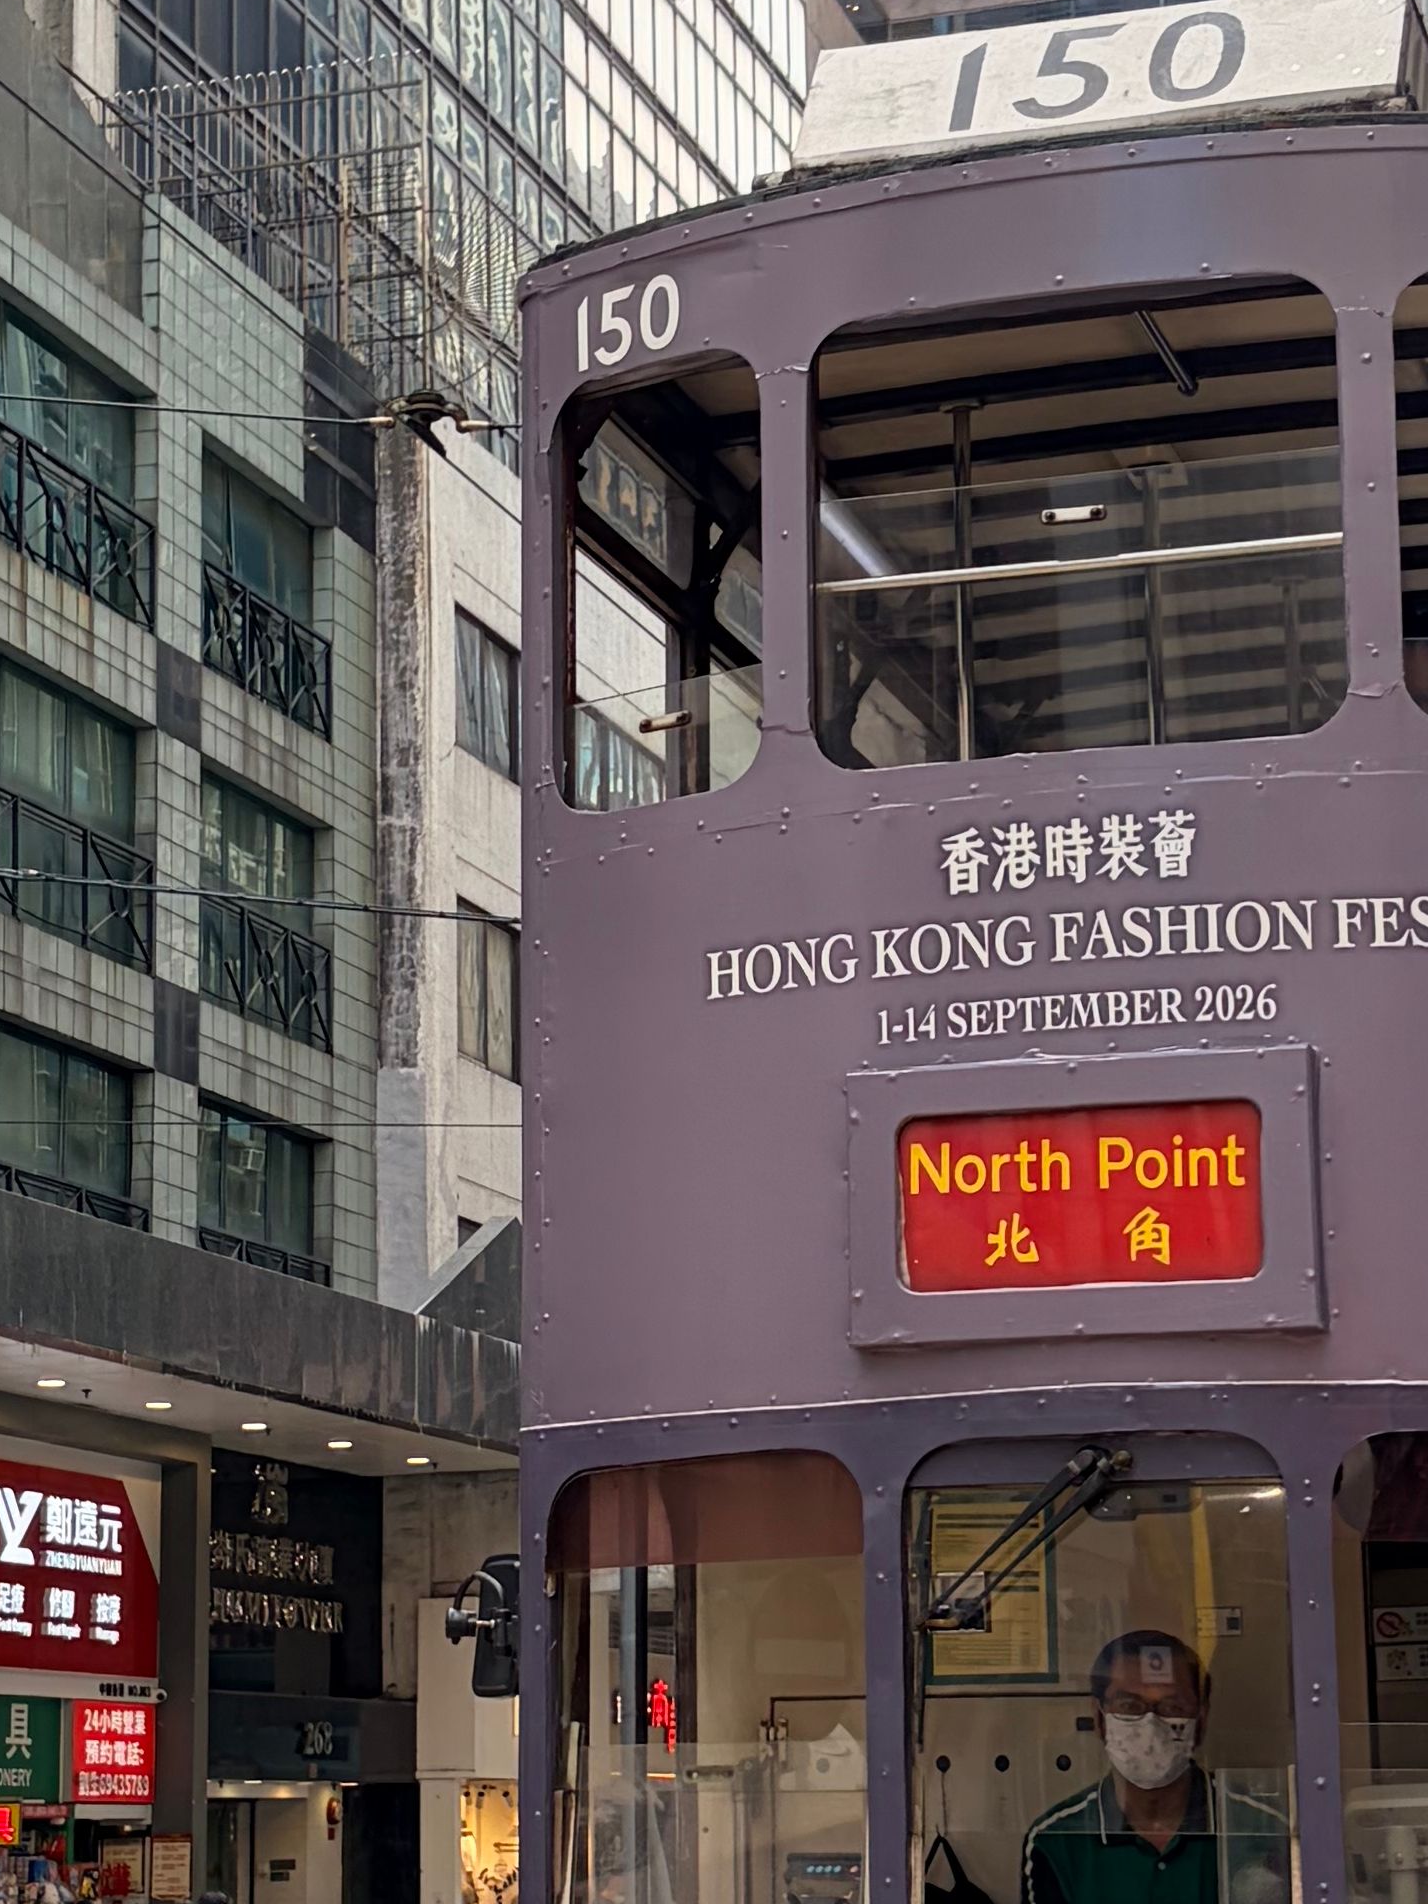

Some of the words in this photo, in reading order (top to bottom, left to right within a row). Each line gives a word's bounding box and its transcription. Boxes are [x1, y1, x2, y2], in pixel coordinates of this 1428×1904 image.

[947, 9, 1248, 134] 150
[575, 272, 681, 375] 150
[939, 809, 1197, 895] 香港時裝薈
[705, 931, 860, 1001] HONG
[871, 914, 1035, 979] KONG
[1052, 898, 1315, 963] FASHION
[875, 1001, 939, 1046] 1-14
[947, 989, 1186, 1040] SEPTEMBER
[1194, 982, 1278, 1024] 2026
[907, 1136, 1072, 1198] North
[1096, 1133, 1247, 1191] Point
[983, 1204, 1174, 1268] 北角
